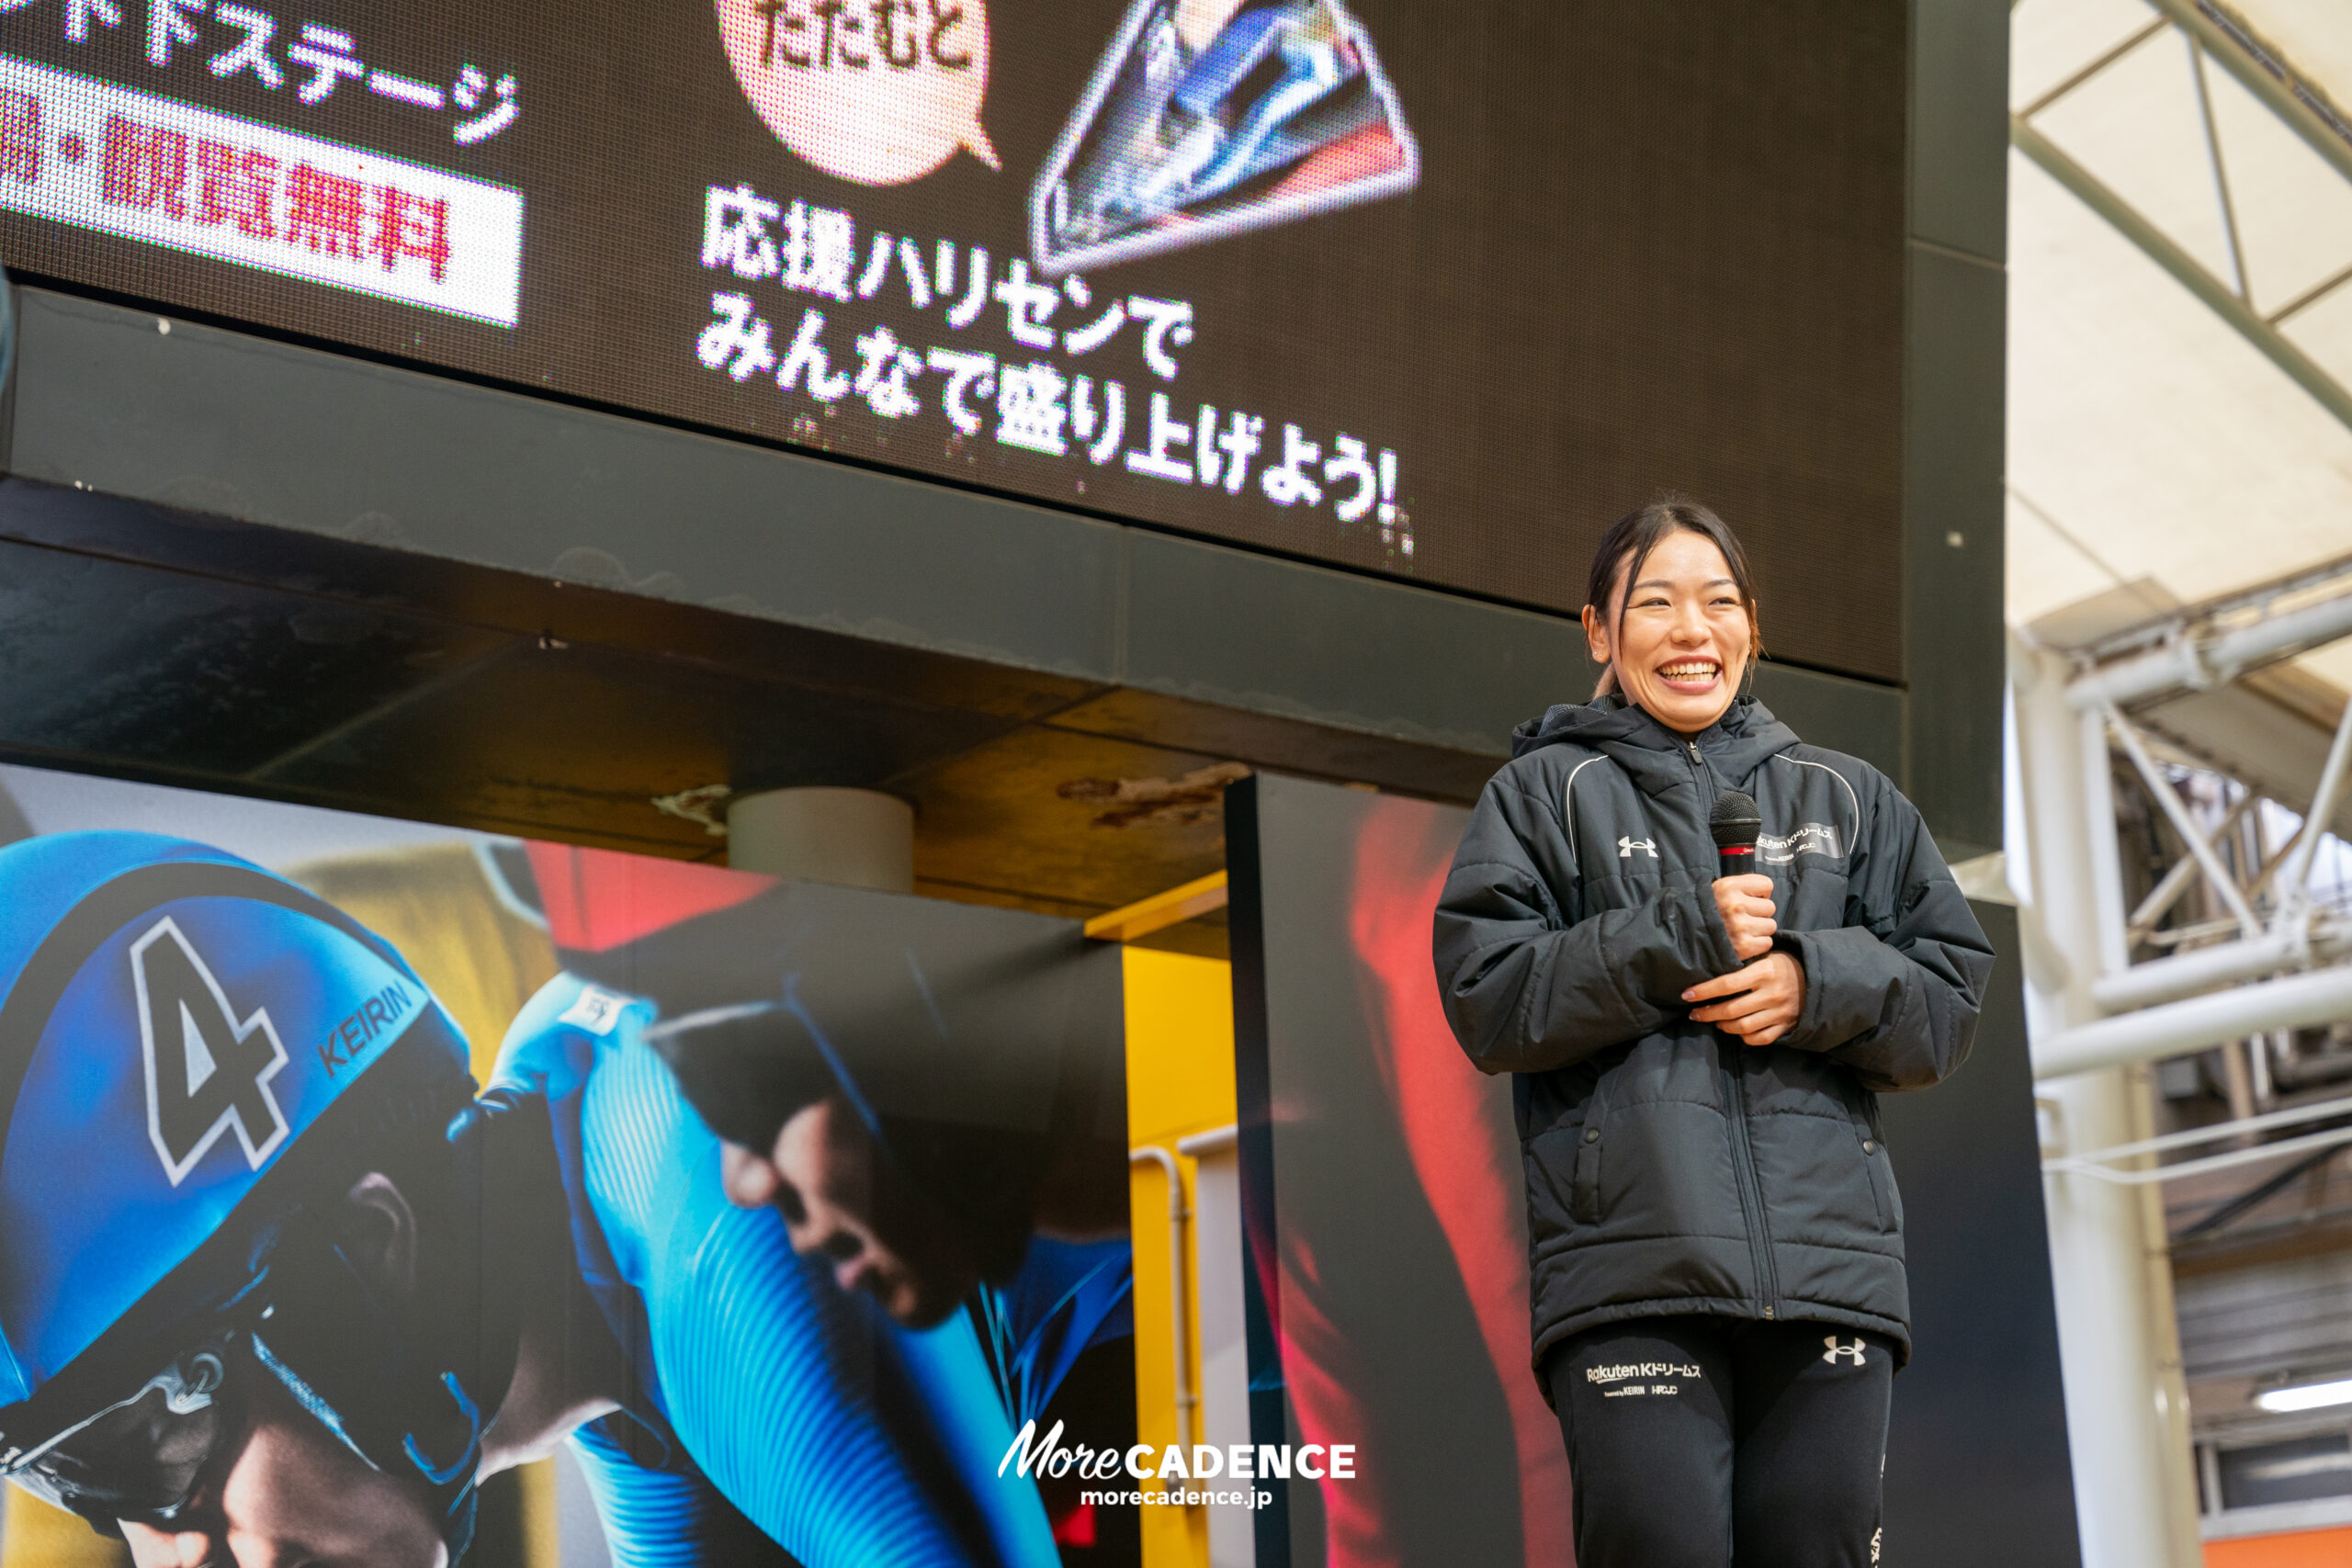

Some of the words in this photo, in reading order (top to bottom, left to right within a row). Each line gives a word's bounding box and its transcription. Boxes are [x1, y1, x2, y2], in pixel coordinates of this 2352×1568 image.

[700, 184, 1194, 379] 応援ハリセンで
[696, 291, 1399, 525] みんなで盛り上げよう!
[129, 915, 289, 1188] 4
[317, 977, 412, 1078] KEIRIN
[1587, 1364, 1639, 1383] Rakuten
[1640, 1362, 1702, 1379] Kドリームス
[1623, 1385, 1645, 1396] KEIRIN
